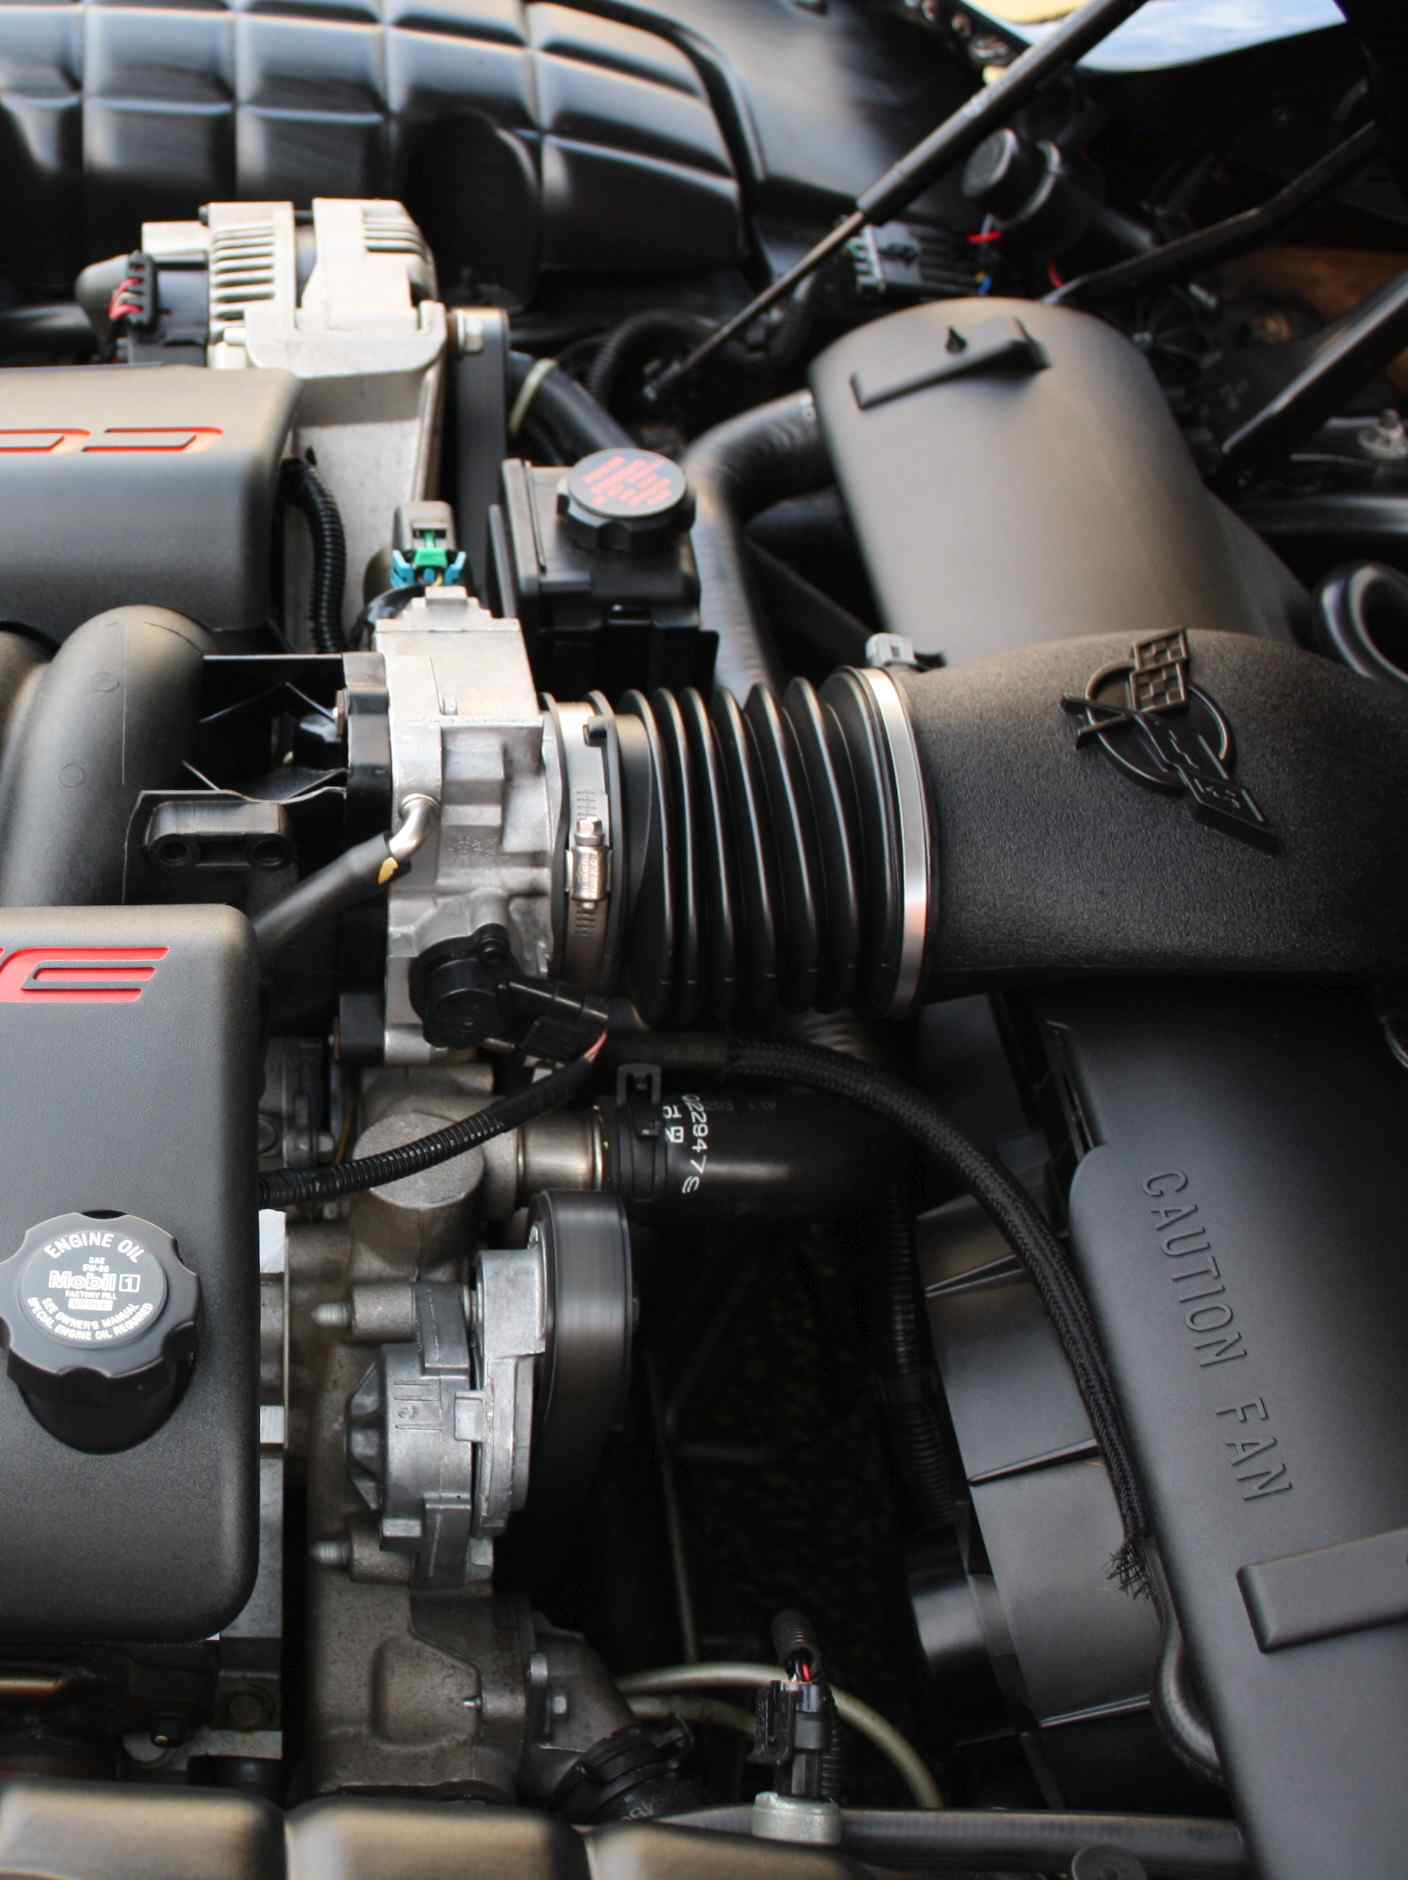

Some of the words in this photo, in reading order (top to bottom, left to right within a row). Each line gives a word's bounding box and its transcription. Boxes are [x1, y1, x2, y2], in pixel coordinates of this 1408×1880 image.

[44, 1232, 114, 1258] ENGINE
[117, 1239, 145, 1263] OIL
[48, 1270, 117, 1292] Mobil
[101, 1303, 141, 1328] MANUAL
[1141, 1168, 1248, 1368] CAUTION
[1215, 1397, 1293, 1502] FAN
